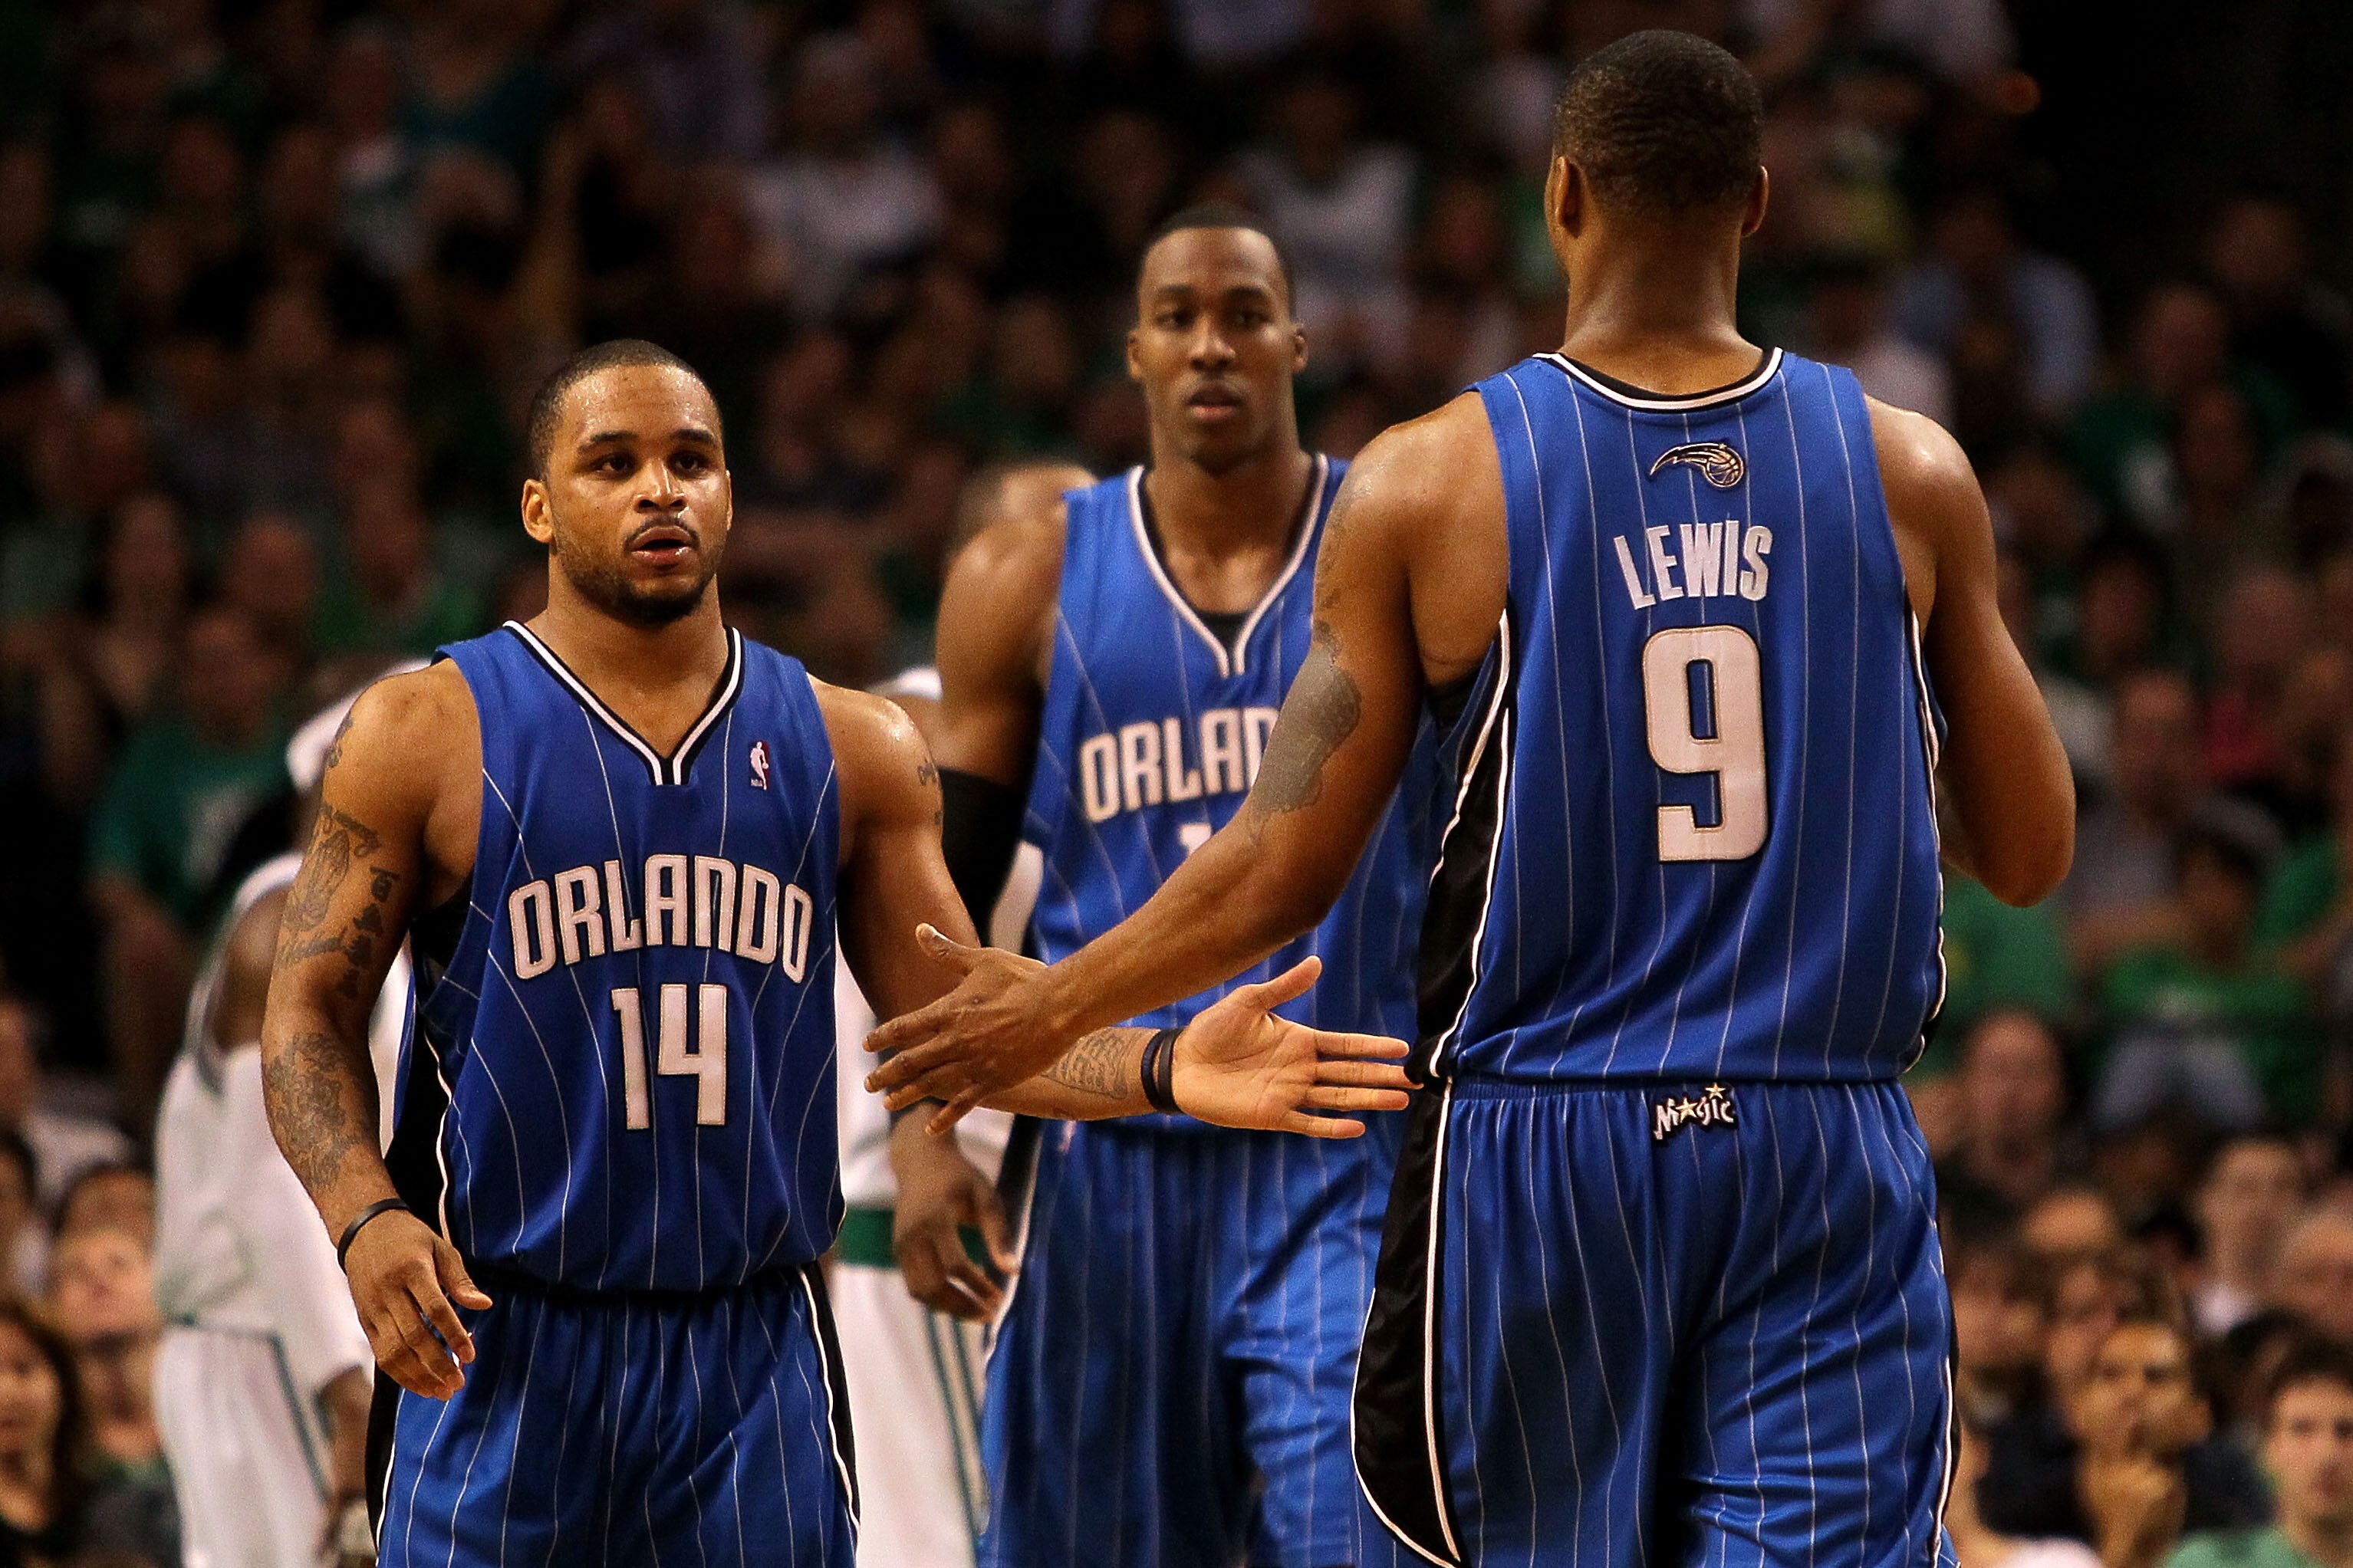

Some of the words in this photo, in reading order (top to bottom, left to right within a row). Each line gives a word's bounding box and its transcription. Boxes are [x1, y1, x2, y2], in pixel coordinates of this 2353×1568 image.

[1613, 519, 1773, 610] LEWIS
[1642, 624, 1769, 863] 9
[508, 853, 814, 985] ORLANDO
[610, 983, 728, 1130] 14
